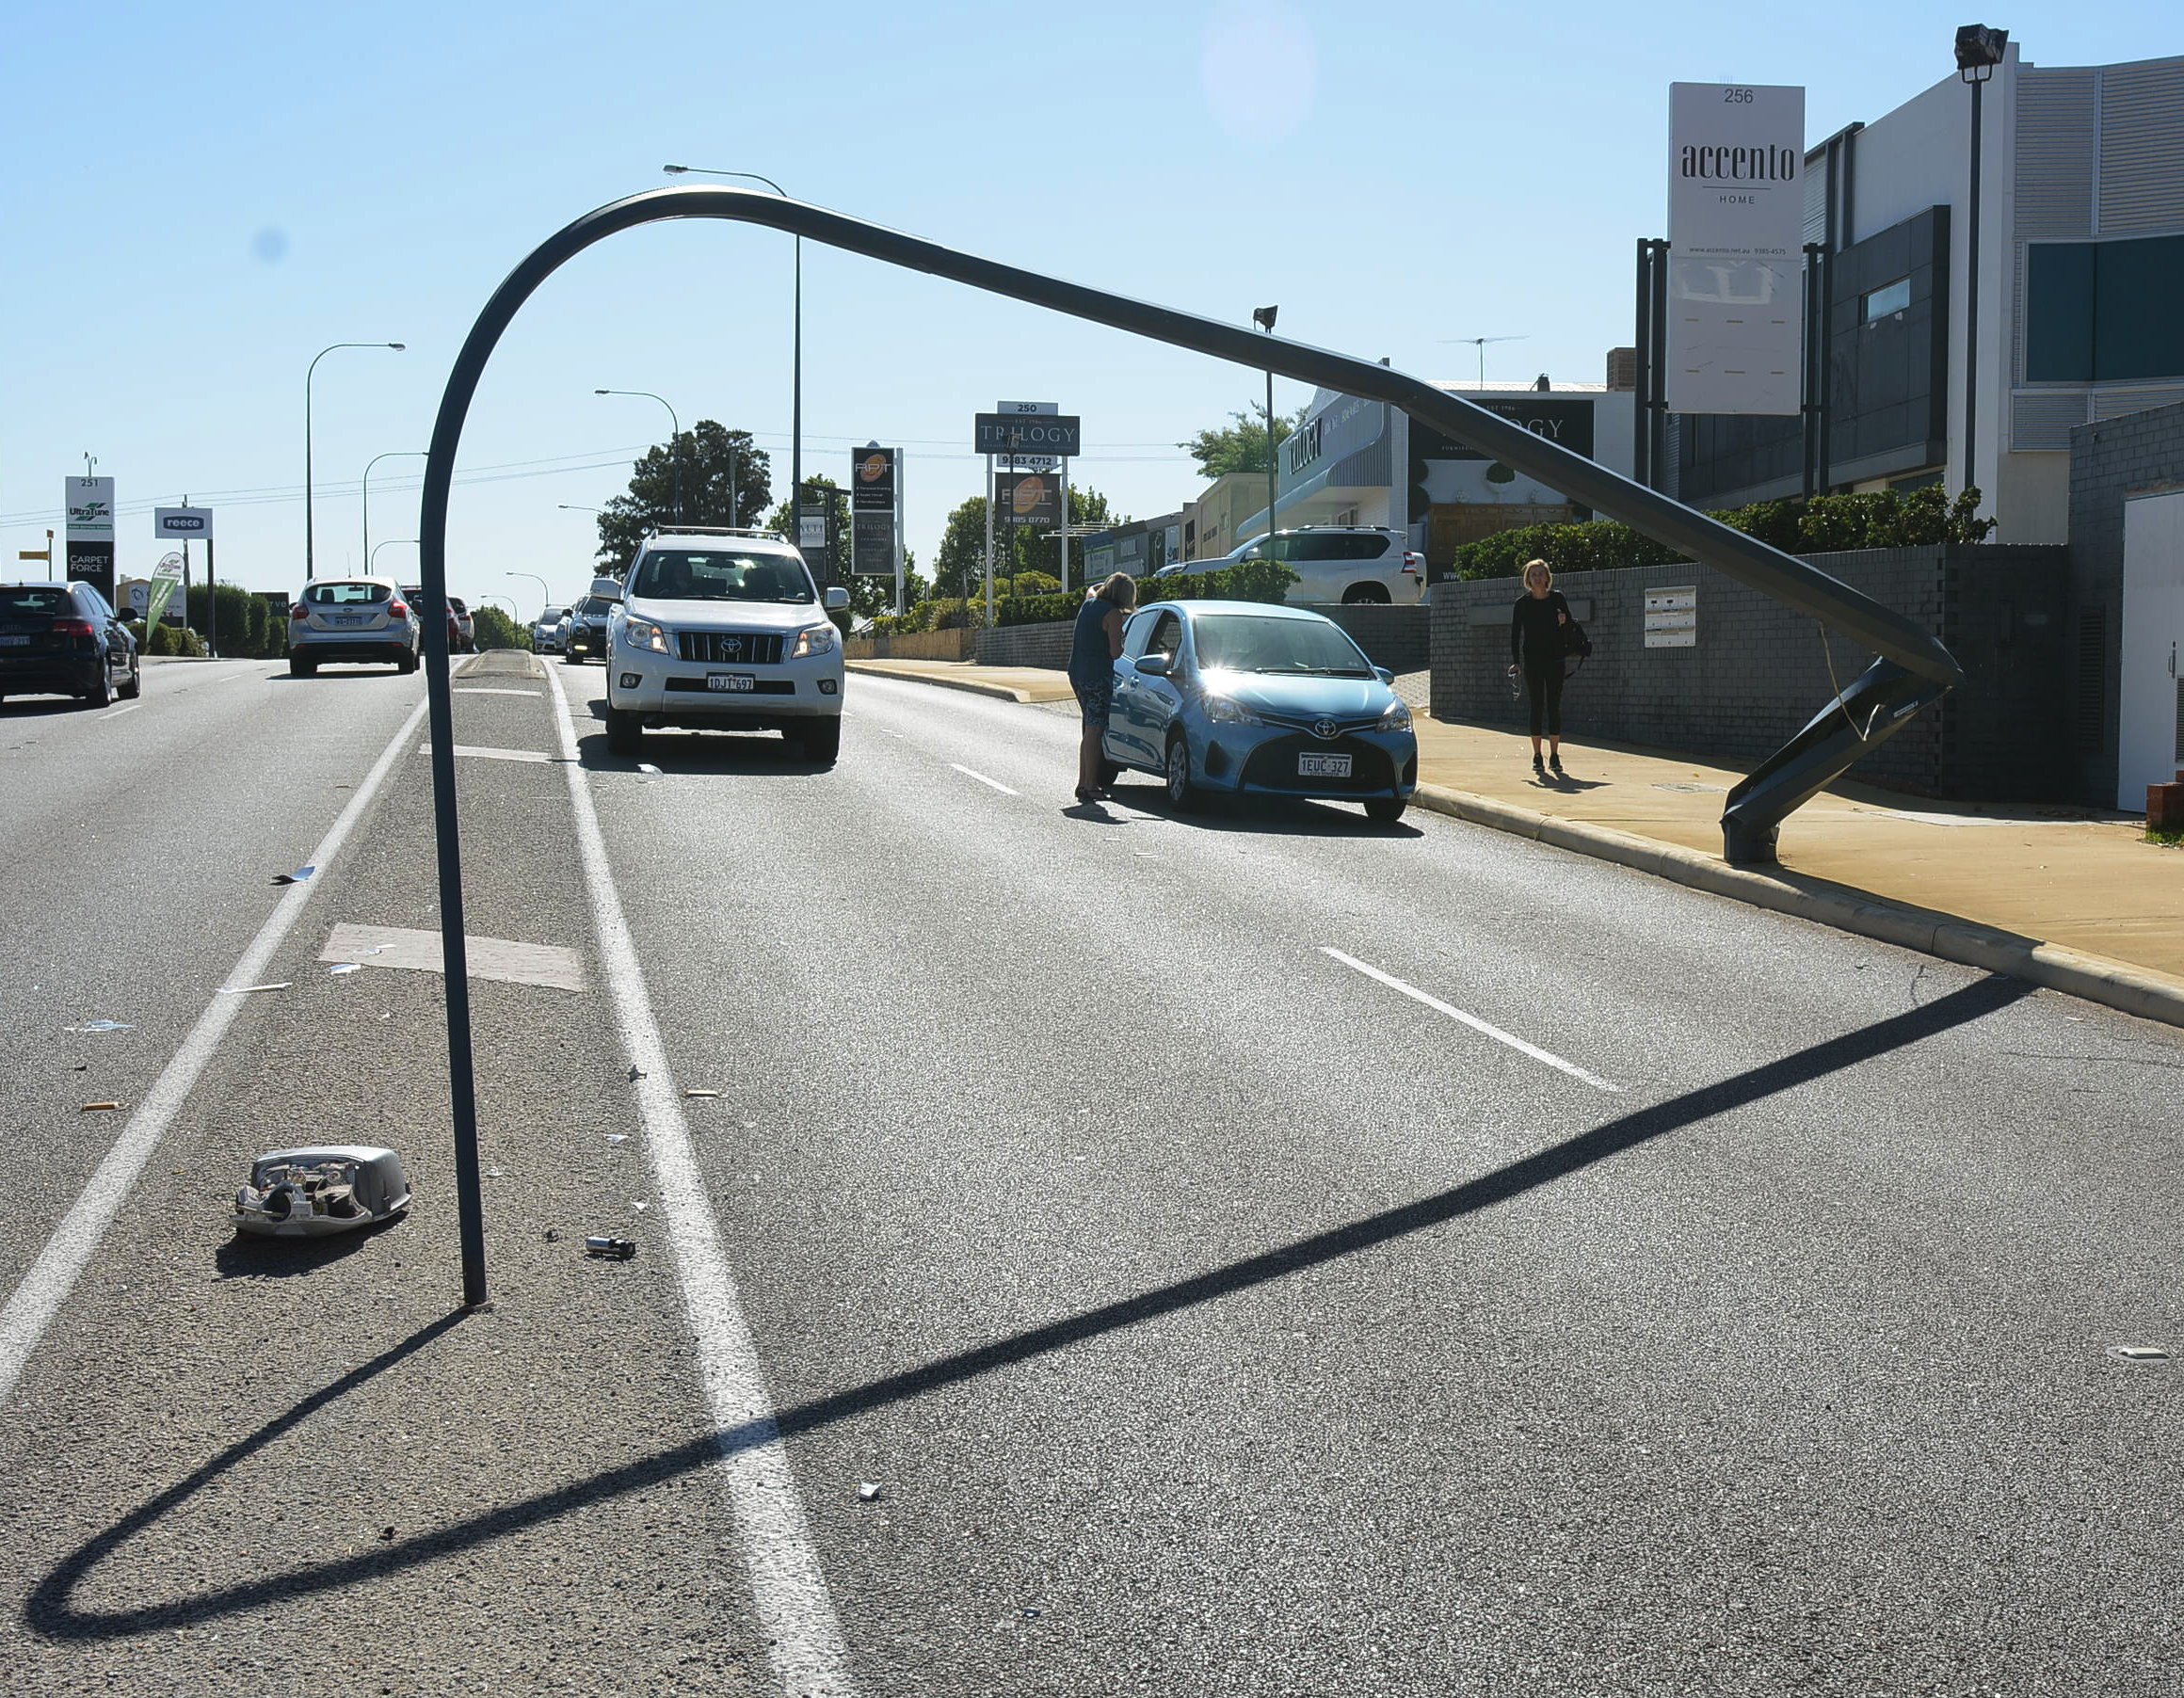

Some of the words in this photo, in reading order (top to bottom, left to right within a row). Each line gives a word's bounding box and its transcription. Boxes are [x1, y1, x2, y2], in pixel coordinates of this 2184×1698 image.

[1724, 88, 1754, 104] 256
[1681, 143, 1795, 181] accento
[1719, 195, 1756, 204] HOME
[1018, 404, 1036, 412] 250
[1288, 417, 1323, 475] TRILOGY
[1029, 457, 1052, 465] 4712
[80, 479, 99, 488] 251
[167, 519, 201, 528] reece
[70, 555, 109, 564] CARPET
[71, 564, 103, 572] FORCE
[735, 679, 752, 689] 697
[1302, 760, 1327, 772] 1EUC
[1331, 761, 1349, 773] 327
